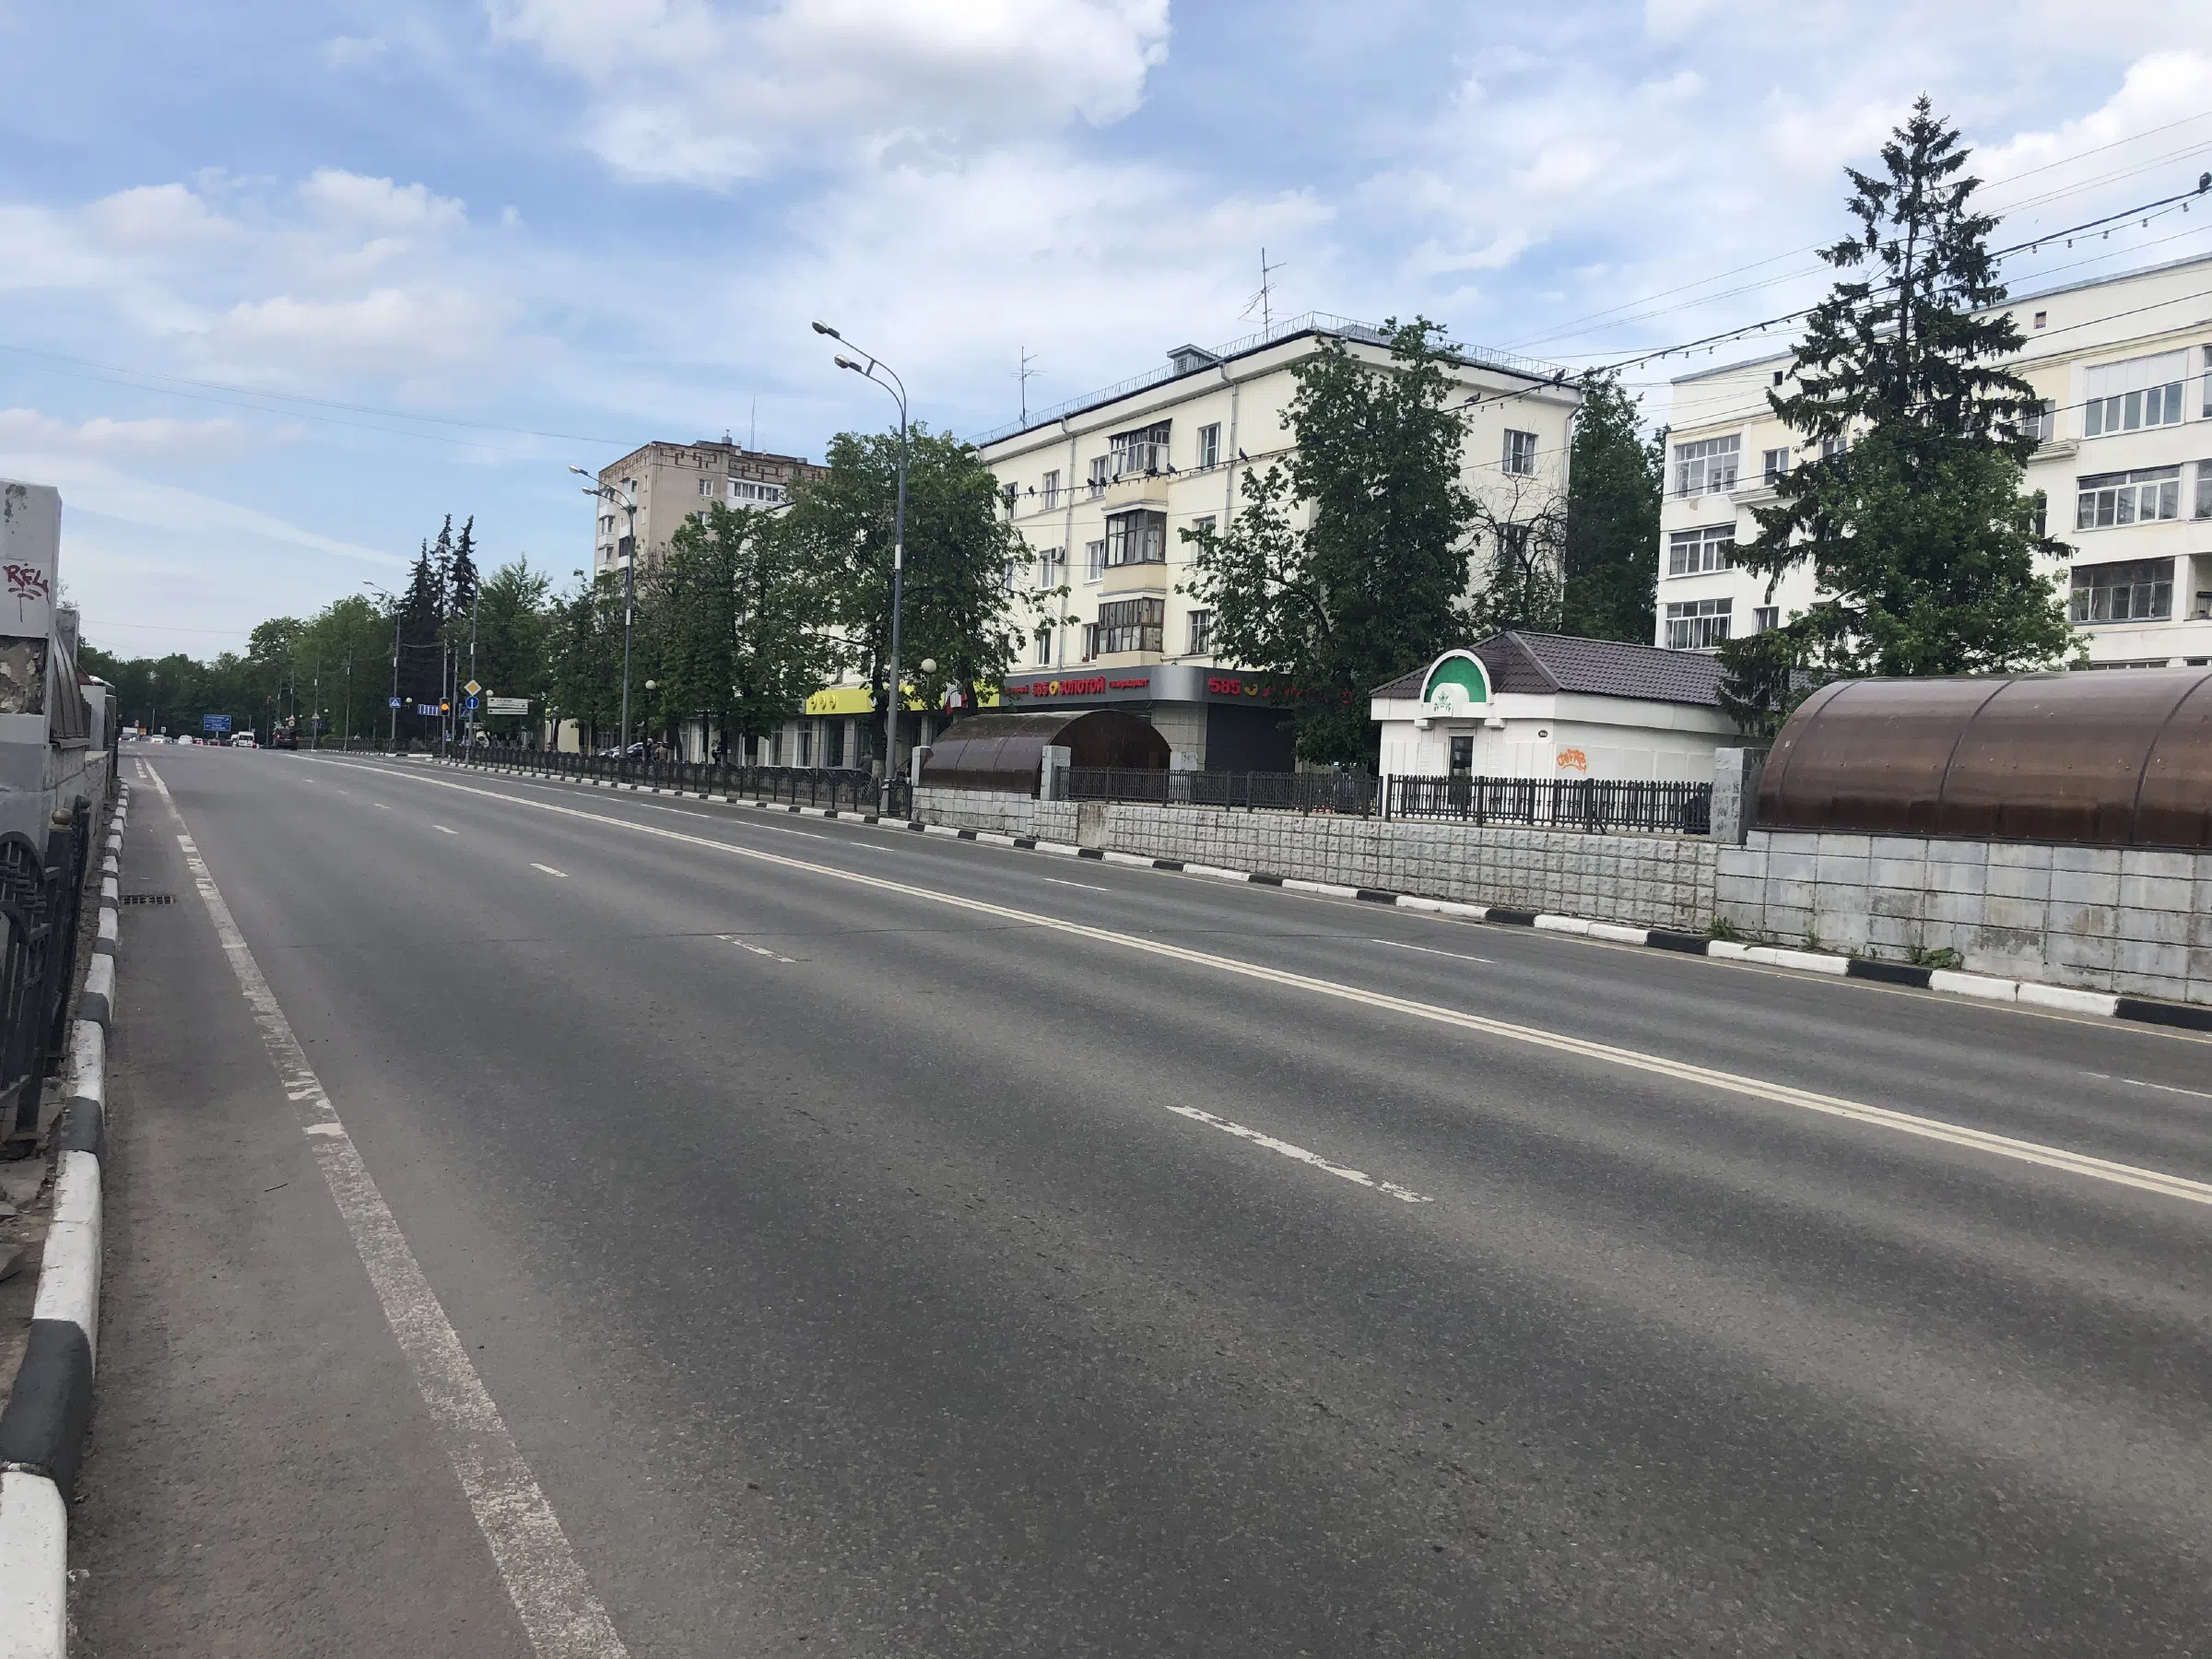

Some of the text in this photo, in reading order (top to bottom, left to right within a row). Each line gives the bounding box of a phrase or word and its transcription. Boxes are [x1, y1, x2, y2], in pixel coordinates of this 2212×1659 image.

[1032, 682, 1049, 697] 585
[1060, 677, 1106, 694] ЗОЛОТОЙ
[1208, 677, 1241, 695] 585
